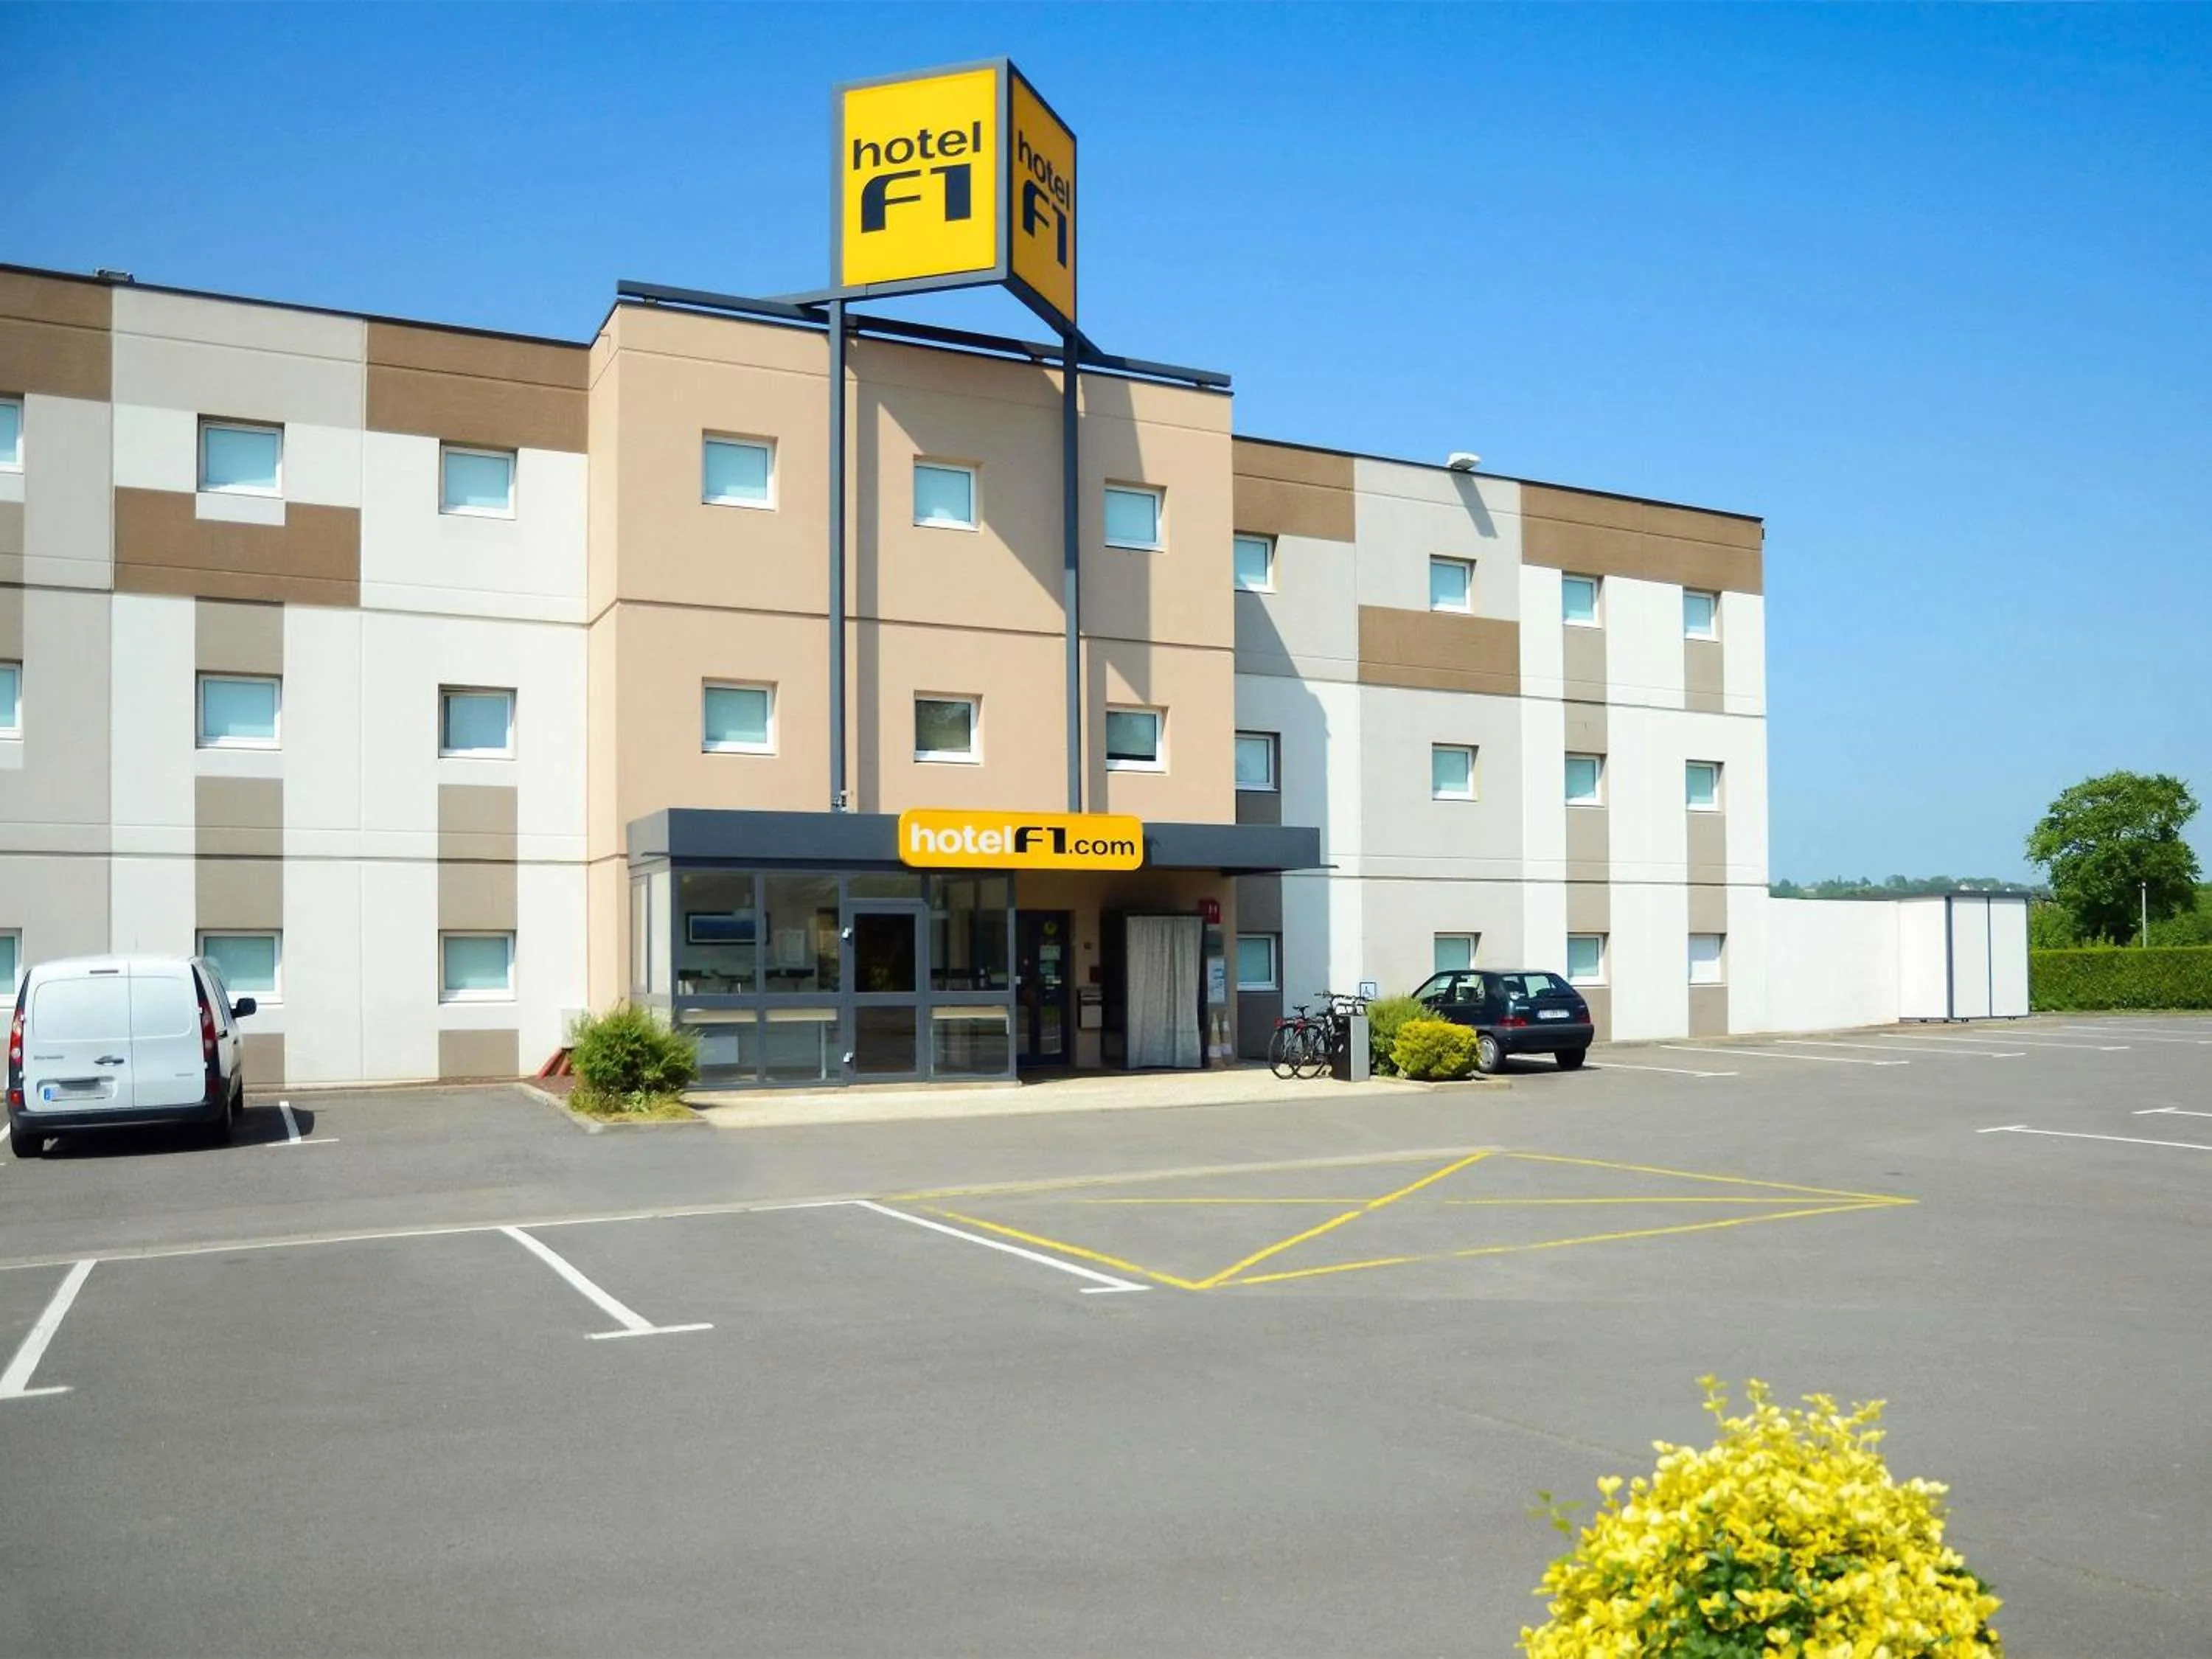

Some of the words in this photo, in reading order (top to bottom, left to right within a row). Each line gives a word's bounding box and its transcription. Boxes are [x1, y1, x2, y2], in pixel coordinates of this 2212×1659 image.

[853, 121, 981, 170] hotel
[1018, 130, 1069, 210] hotel
[860, 163, 971, 233] F1
[1022, 179, 1067, 268] F1
